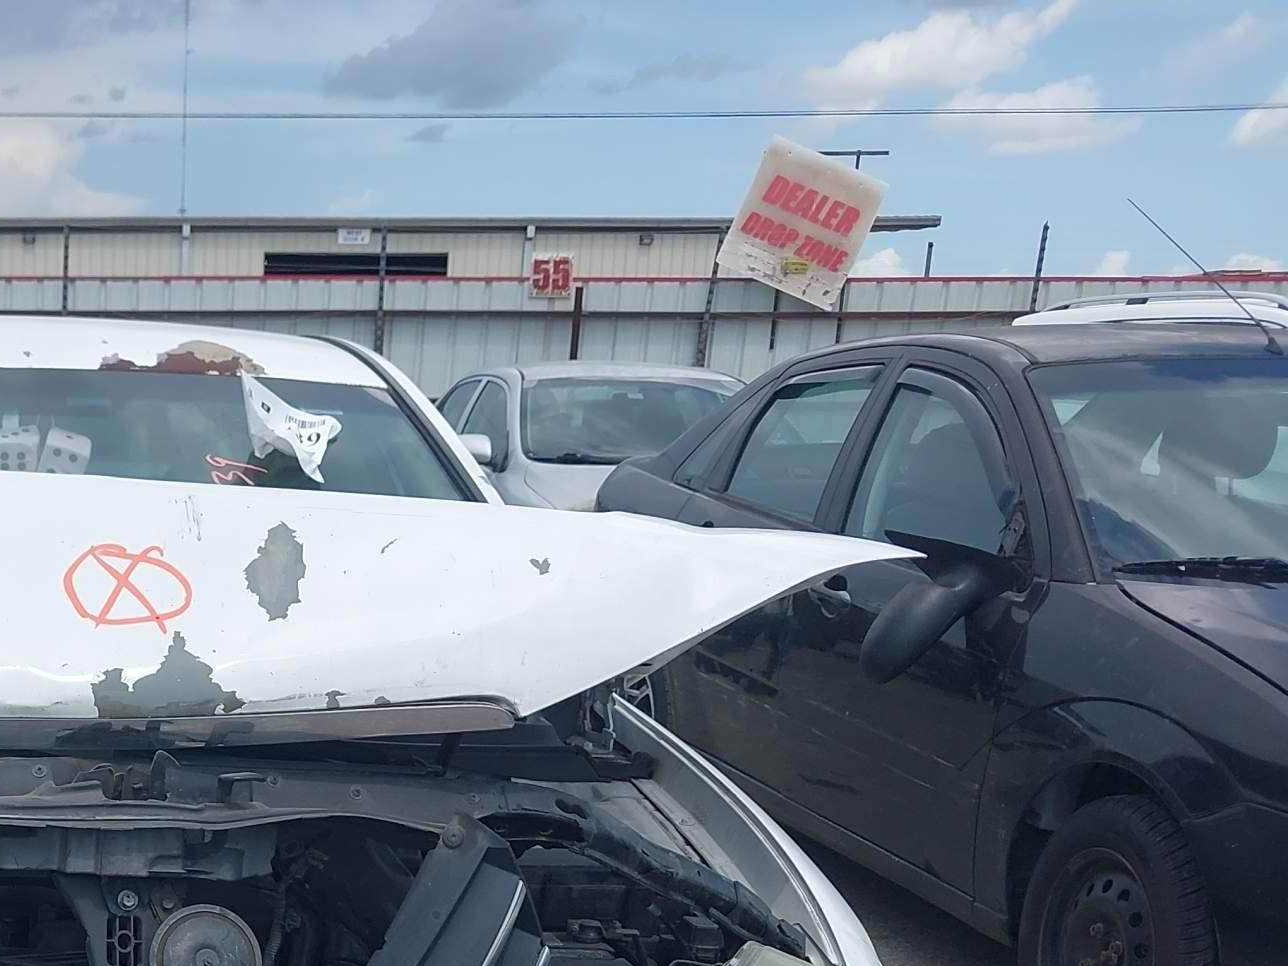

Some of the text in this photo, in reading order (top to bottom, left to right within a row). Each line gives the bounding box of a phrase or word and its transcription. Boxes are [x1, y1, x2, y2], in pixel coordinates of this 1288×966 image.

[762, 175, 861, 238] DEALER
[740, 211, 800, 249] DROP
[793, 234, 849, 273] ZONE
[533, 257, 570, 291] 55
